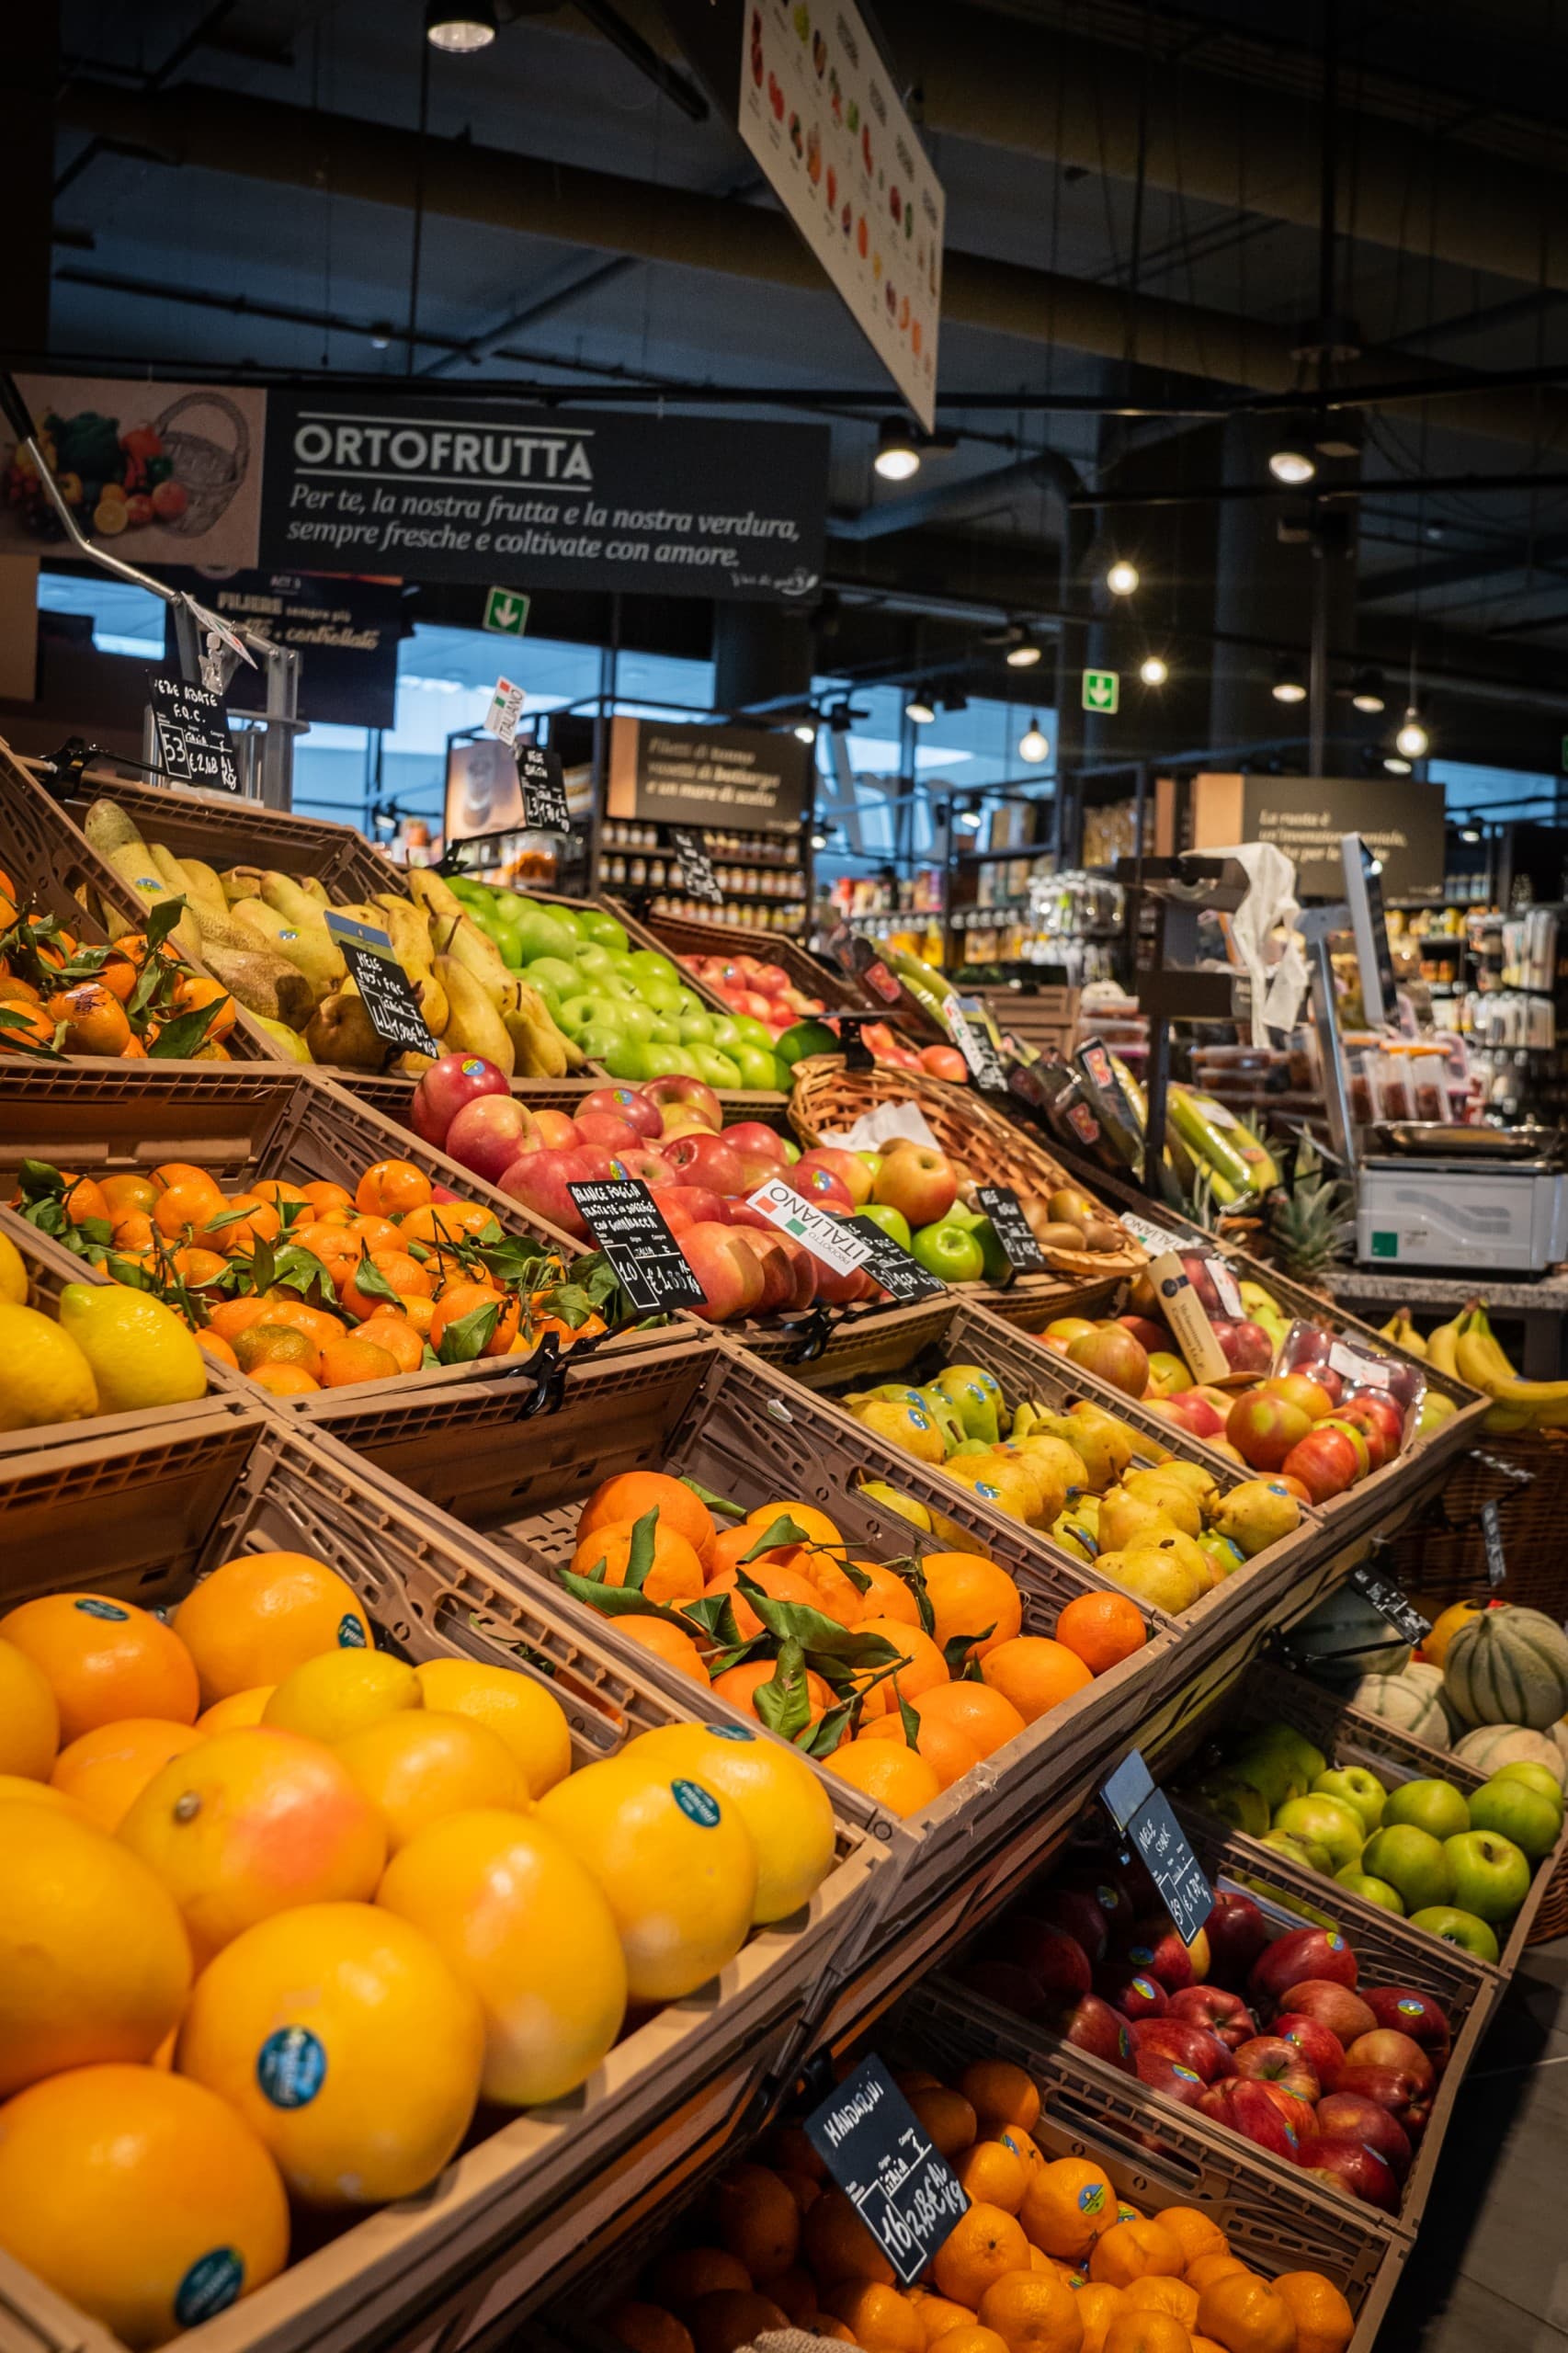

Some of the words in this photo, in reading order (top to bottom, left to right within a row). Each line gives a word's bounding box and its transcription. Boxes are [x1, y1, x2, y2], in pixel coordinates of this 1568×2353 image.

[293, 424, 593, 480] ORTOFRUTTA
[290, 483, 334, 509] Per
[338, 489, 366, 516] te,
[372, 487, 395, 514] la
[401, 494, 480, 520] nostra
[482, 495, 557, 527] frutta
[563, 506, 579, 525] e
[584, 502, 607, 527] la
[612, 509, 692, 533] nostra
[698, 512, 800, 541] verdura,
[287, 520, 378, 549] sempre
[379, 520, 468, 551] fresche
[474, 535, 491, 551] e
[494, 529, 602, 558] coltivate
[605, 541, 648, 561] con
[654, 544, 739, 566] amore.
[154, 679, 179, 697] ERE
[162, 733, 186, 762] 53
[770, 1186, 865, 1260] ITALIANO
[824, 2073, 884, 2147] MANDARINI
[881, 2204, 912, 2257] 16
